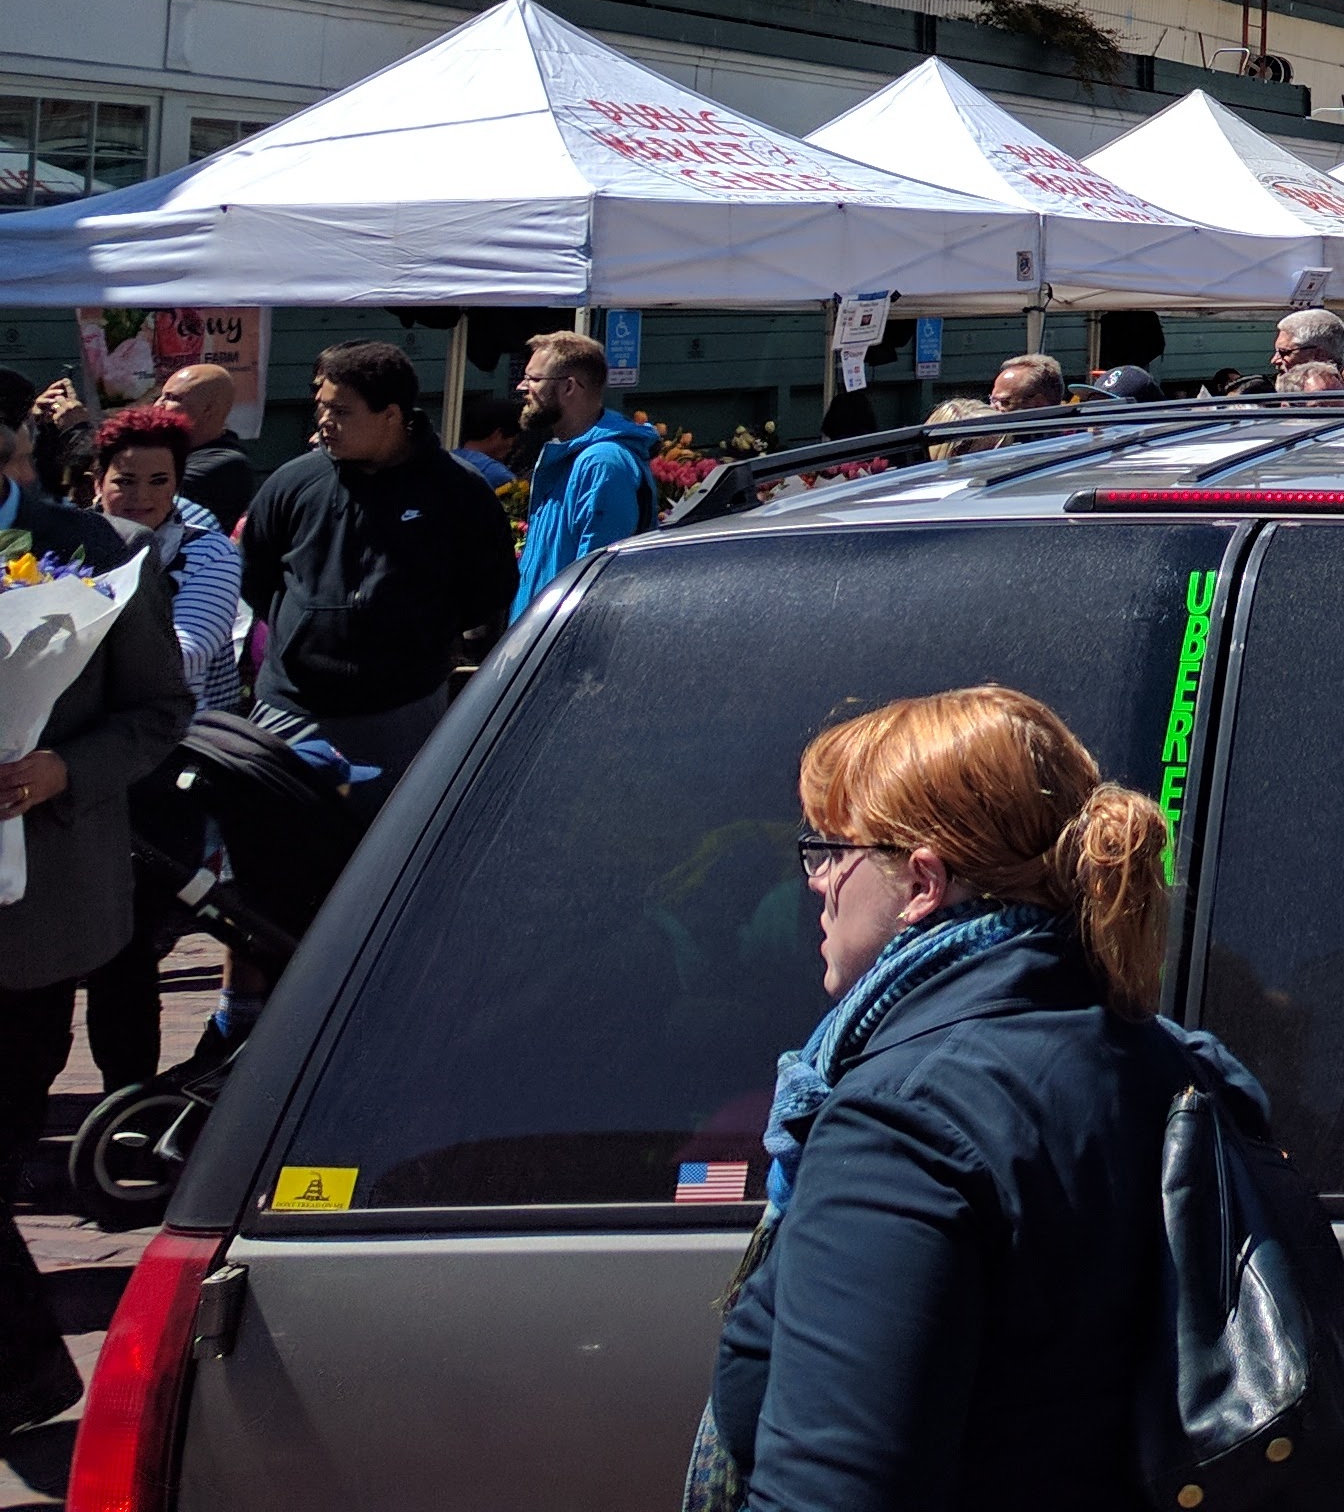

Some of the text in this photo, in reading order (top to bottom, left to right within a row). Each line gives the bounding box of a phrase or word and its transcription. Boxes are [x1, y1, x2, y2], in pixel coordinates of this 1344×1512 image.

[584, 98, 748, 138] PUBLIC
[589, 130, 769, 168] MARKET
[1002, 143, 1094, 177] PUBL
[680, 169, 856, 193] CENTER
[204, 351, 240, 364] FARM
[1161, 569, 1218, 763] UBER
